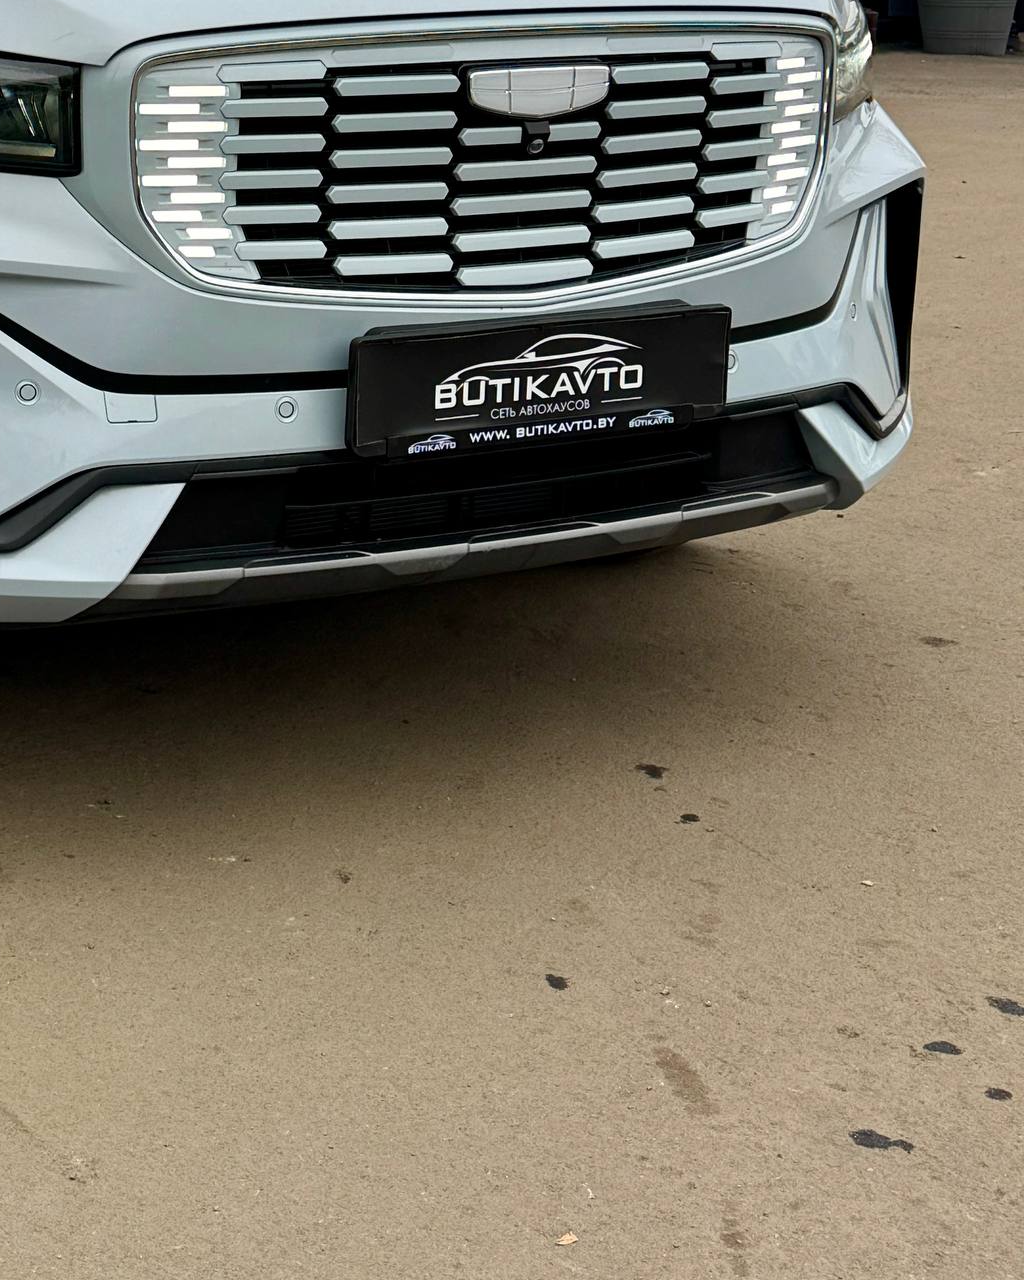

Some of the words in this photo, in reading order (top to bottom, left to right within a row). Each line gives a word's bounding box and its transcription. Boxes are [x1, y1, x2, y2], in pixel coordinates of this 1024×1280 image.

[434, 364, 643, 410] BUTIKAVTO
[490, 407, 516, 420] СЕТЬ
[518, 399, 591, 417] АВТОХАУСОВ
[469, 429, 510, 443] WWW.
[516, 416, 616, 439] BUTIKAVTO.BY
[628, 416, 675, 428] BUTIKAVTO
[407, 441, 457, 455] BUTIKAVTO
